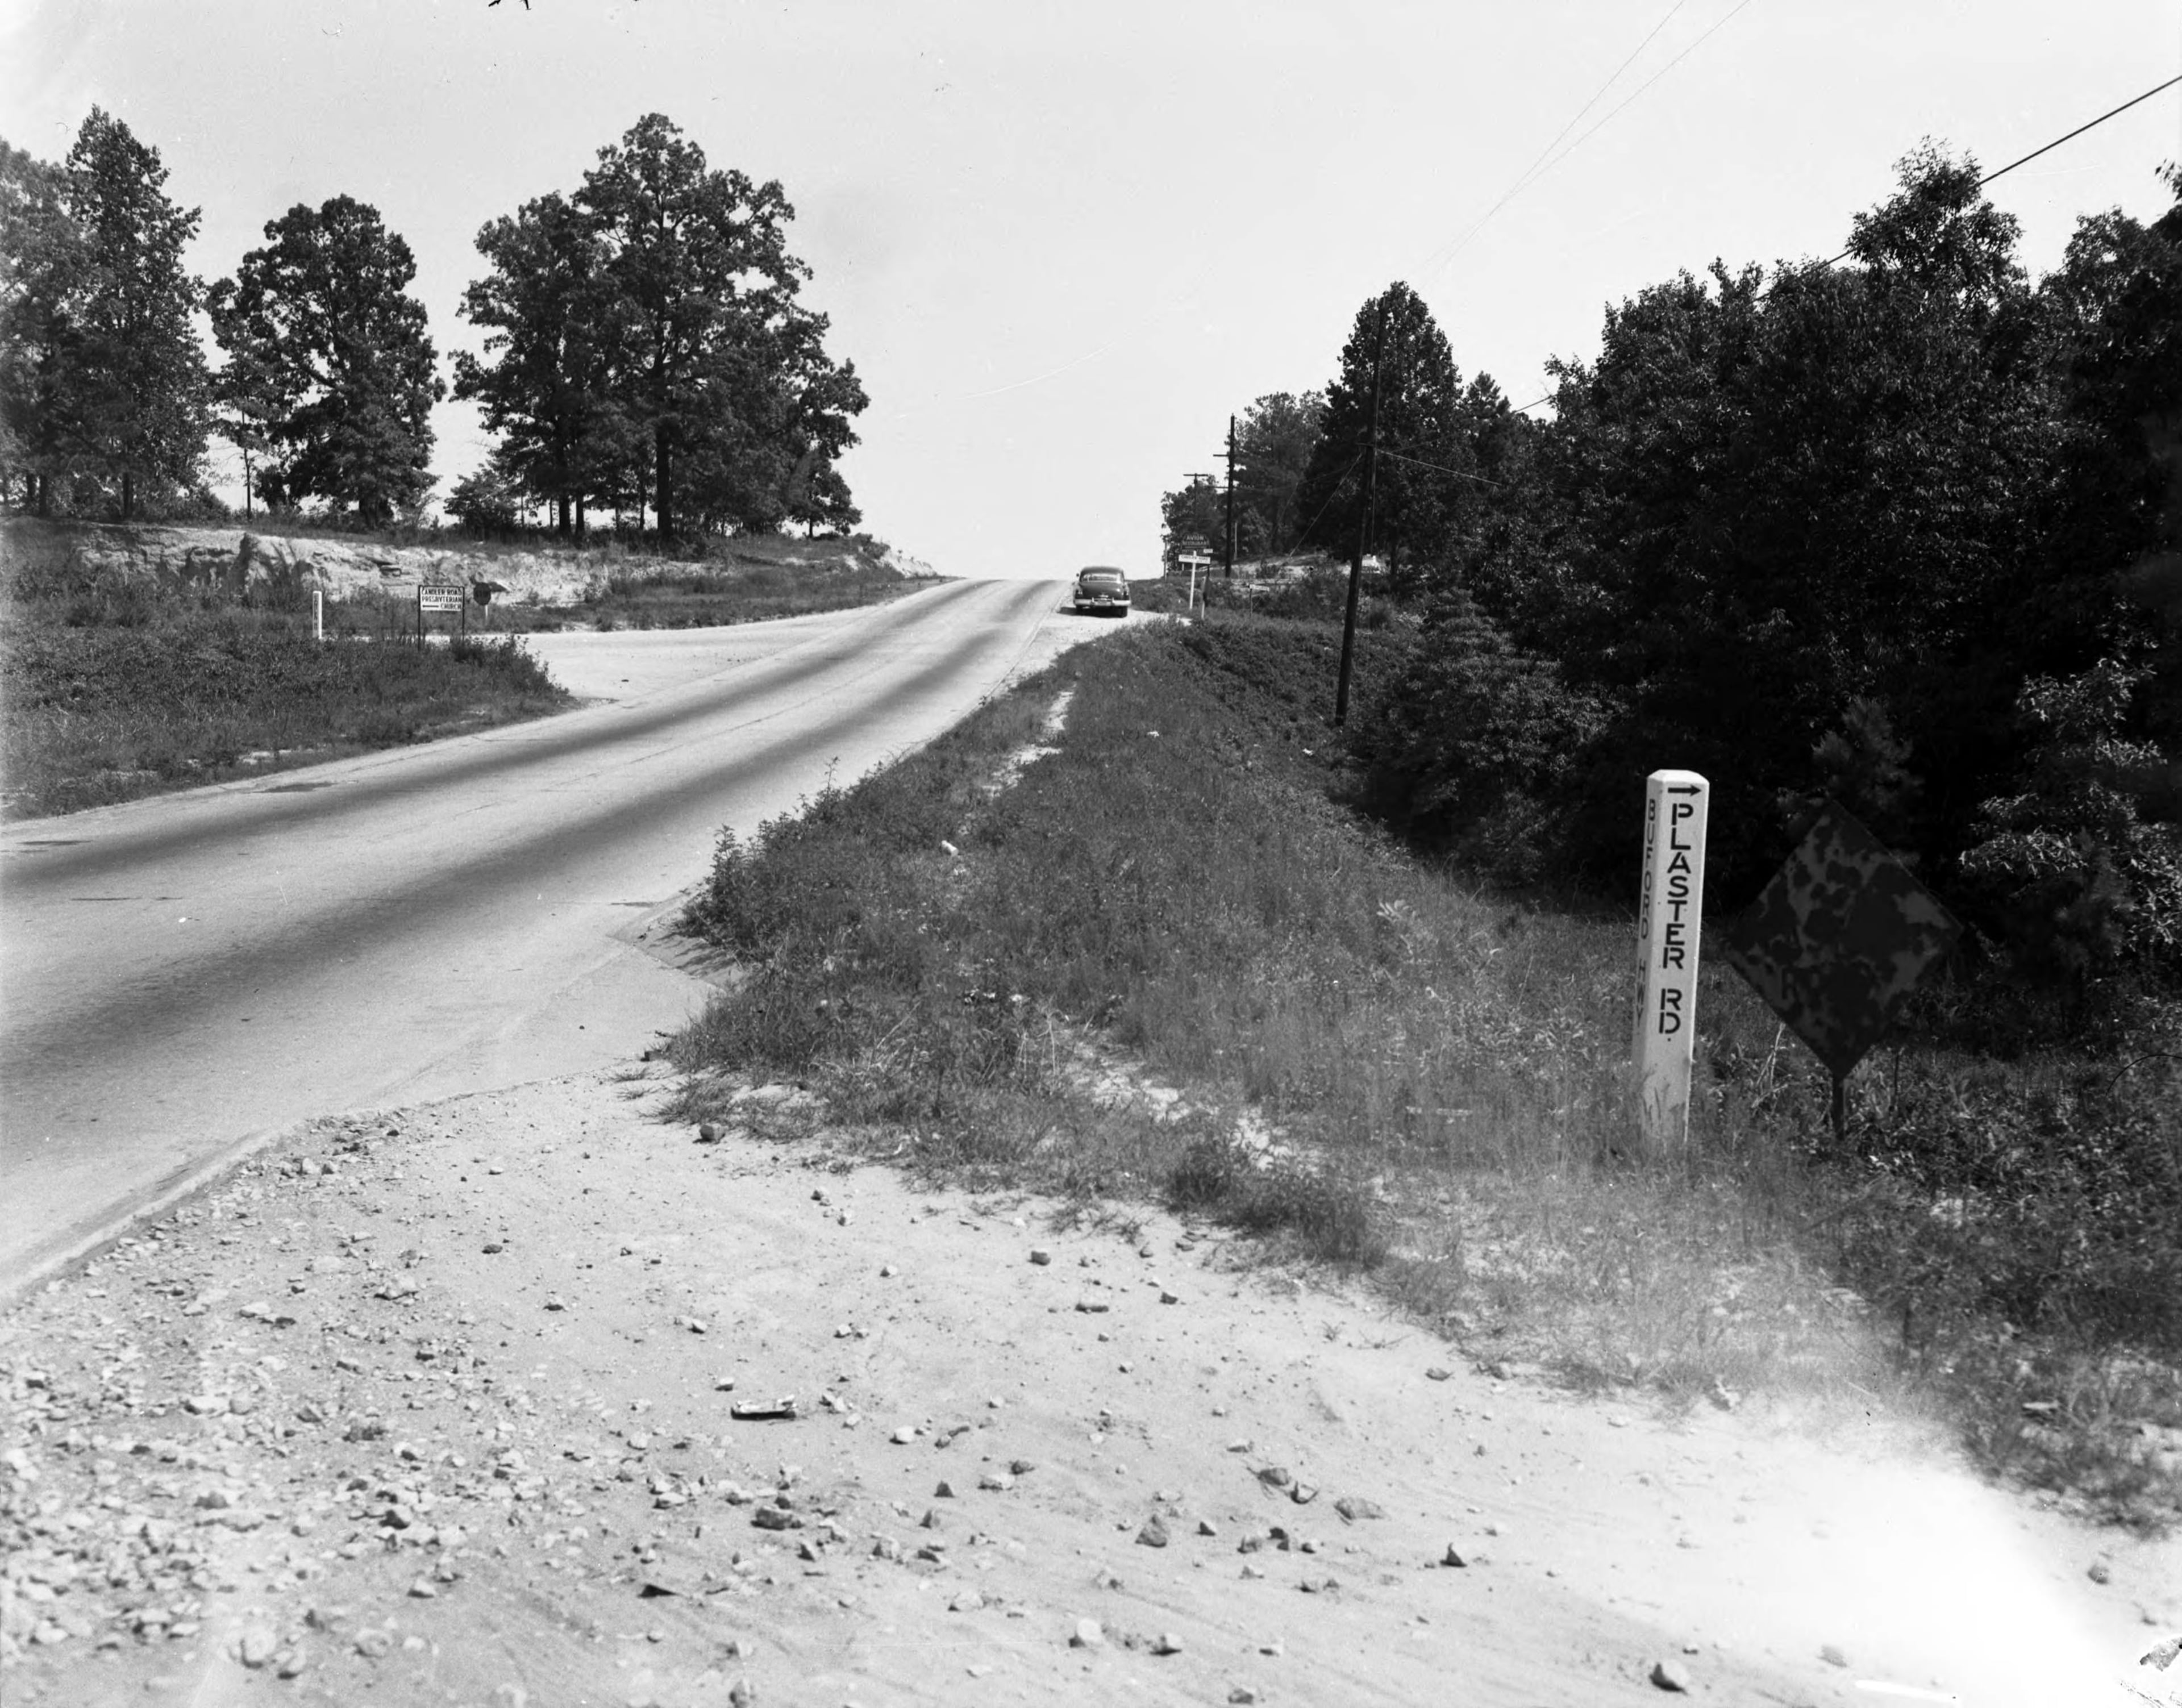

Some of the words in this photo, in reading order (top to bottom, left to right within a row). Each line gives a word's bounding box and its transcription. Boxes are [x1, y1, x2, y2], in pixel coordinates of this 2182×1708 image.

[1640, 799, 1656, 939] BUFORD
[1662, 803, 1694, 969] PLASTER
[1636, 957, 1646, 1028] HWY
